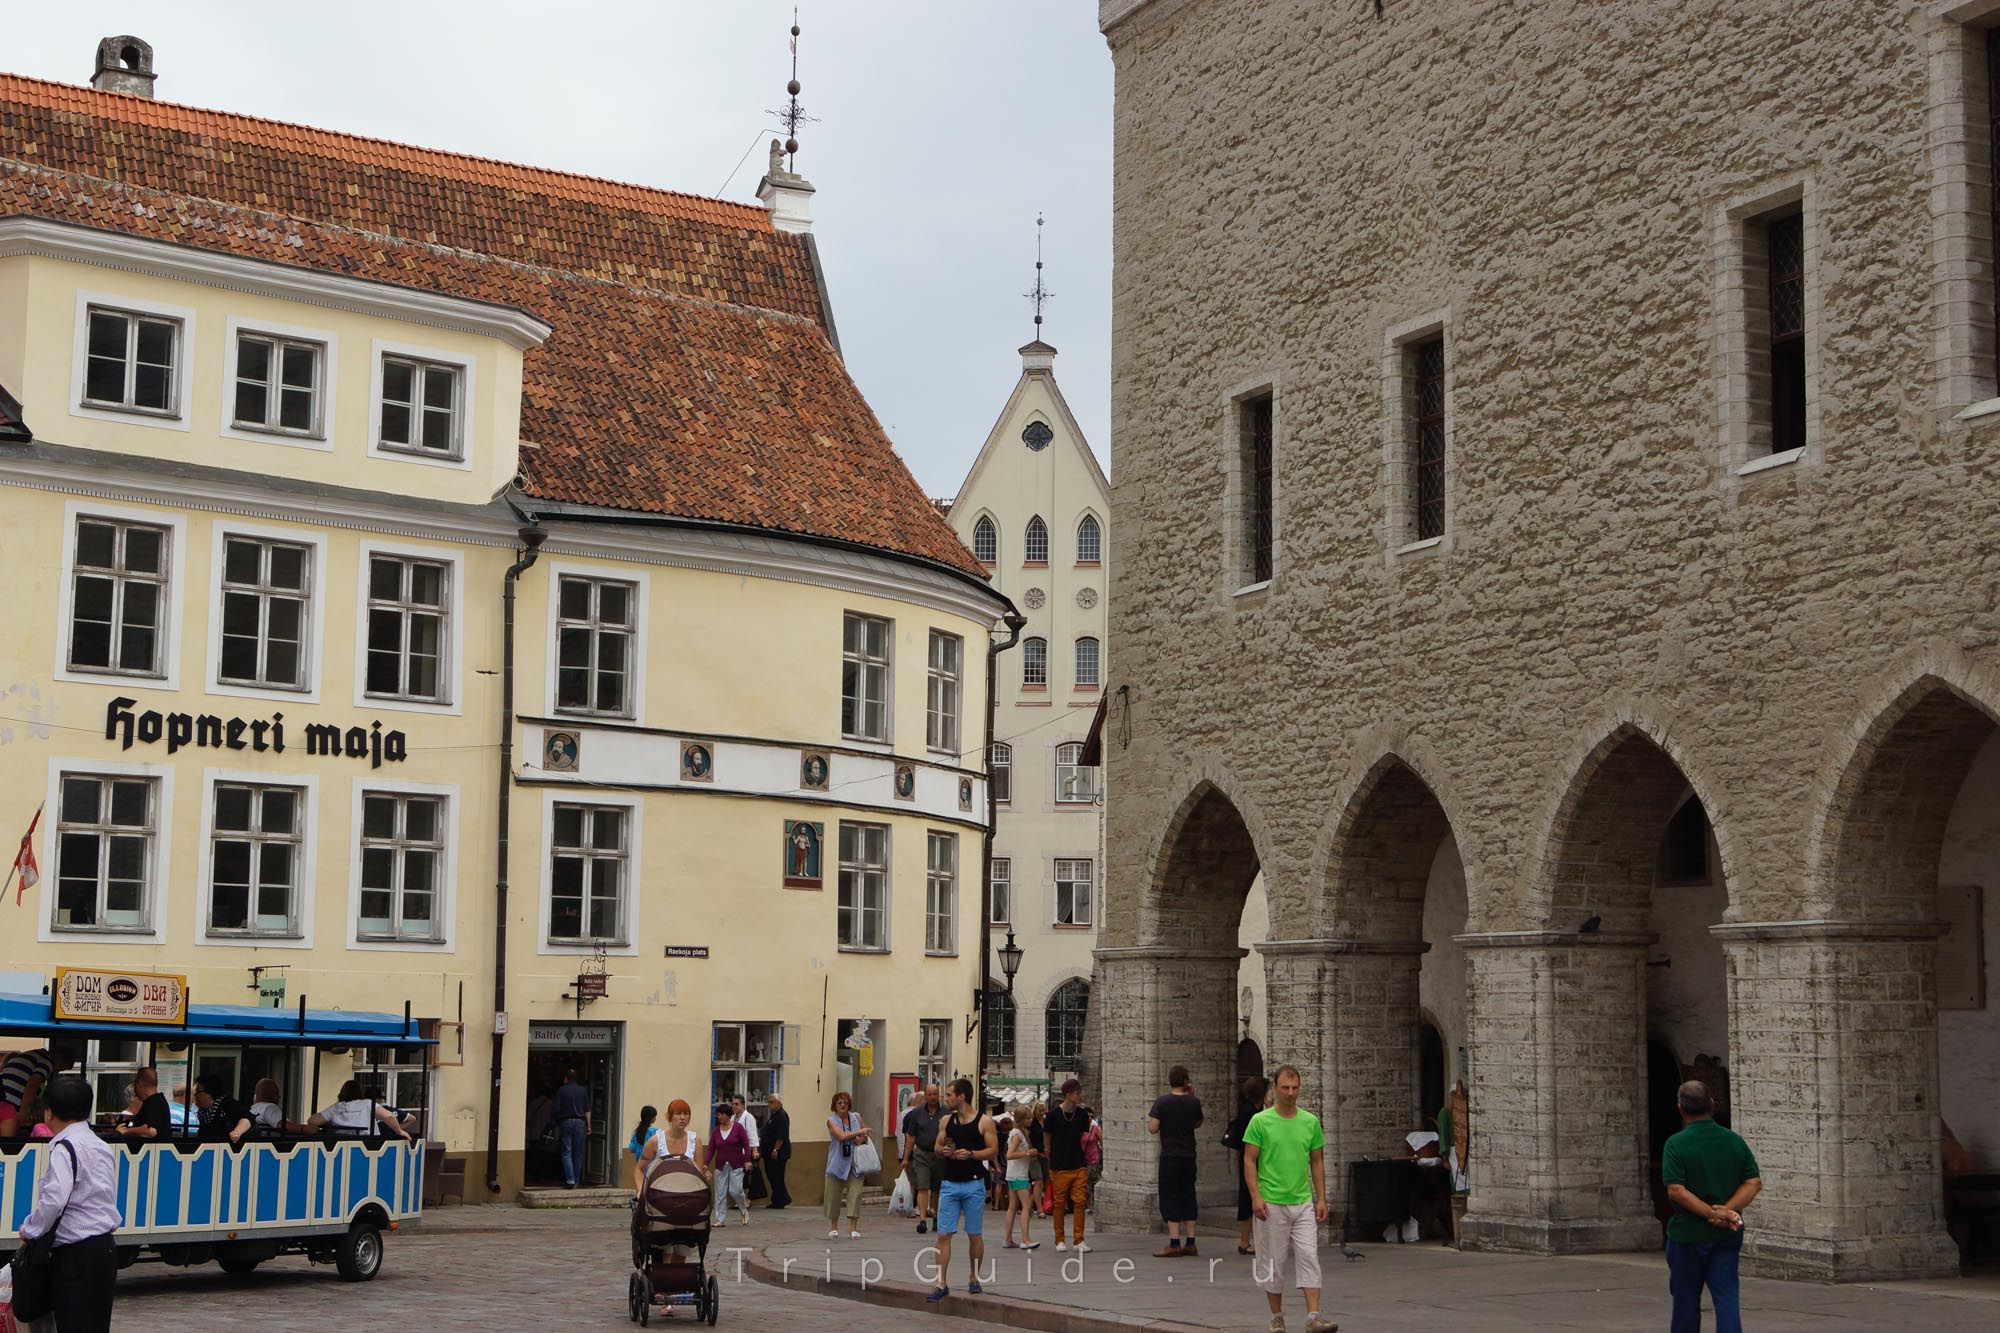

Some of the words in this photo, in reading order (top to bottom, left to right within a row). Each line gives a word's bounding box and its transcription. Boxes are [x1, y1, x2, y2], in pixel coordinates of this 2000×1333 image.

[305, 719, 407, 769] maja
[667, 948, 691, 957] Raekoja
[109, 984, 138, 995] ILLUSION
[143, 984, 167, 1002] ДВА
[74, 1000, 102, 1012] ФИГУР
[535, 1030, 561, 1040] Baltic
[575, 1031, 606, 1040] Amber
